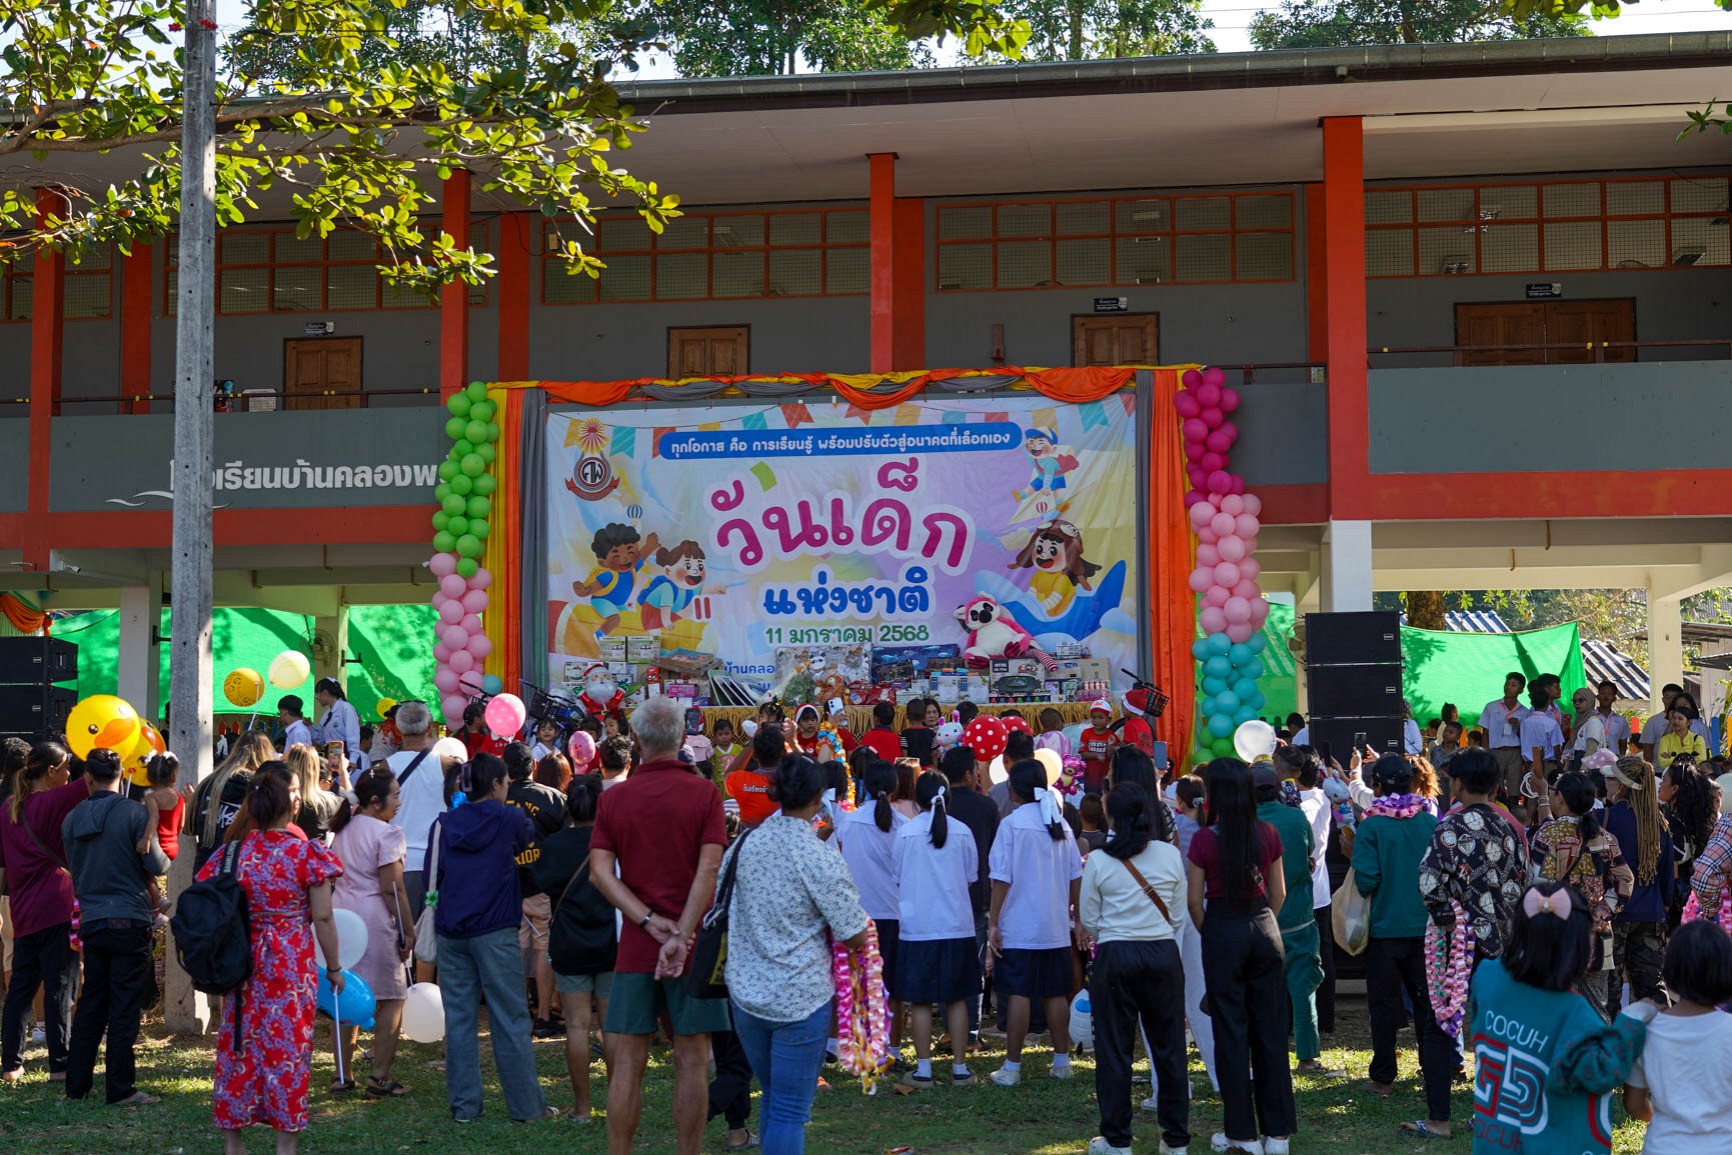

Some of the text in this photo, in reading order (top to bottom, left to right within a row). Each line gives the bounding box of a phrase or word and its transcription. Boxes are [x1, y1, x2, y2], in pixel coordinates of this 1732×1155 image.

[671, 427, 1011, 457] ทุกโอกาส คือ การเรียนรู้ พร้อมปรับตัวสู่อนาคตที่เลือกเอง
[170, 455, 447, 490] เรียนบ้านคลองพ
[711, 457, 968, 567] วันเด็ก
[763, 566, 930, 614] แห่งชาติ
[766, 625, 929, 644] 11 มกราคม 2568
